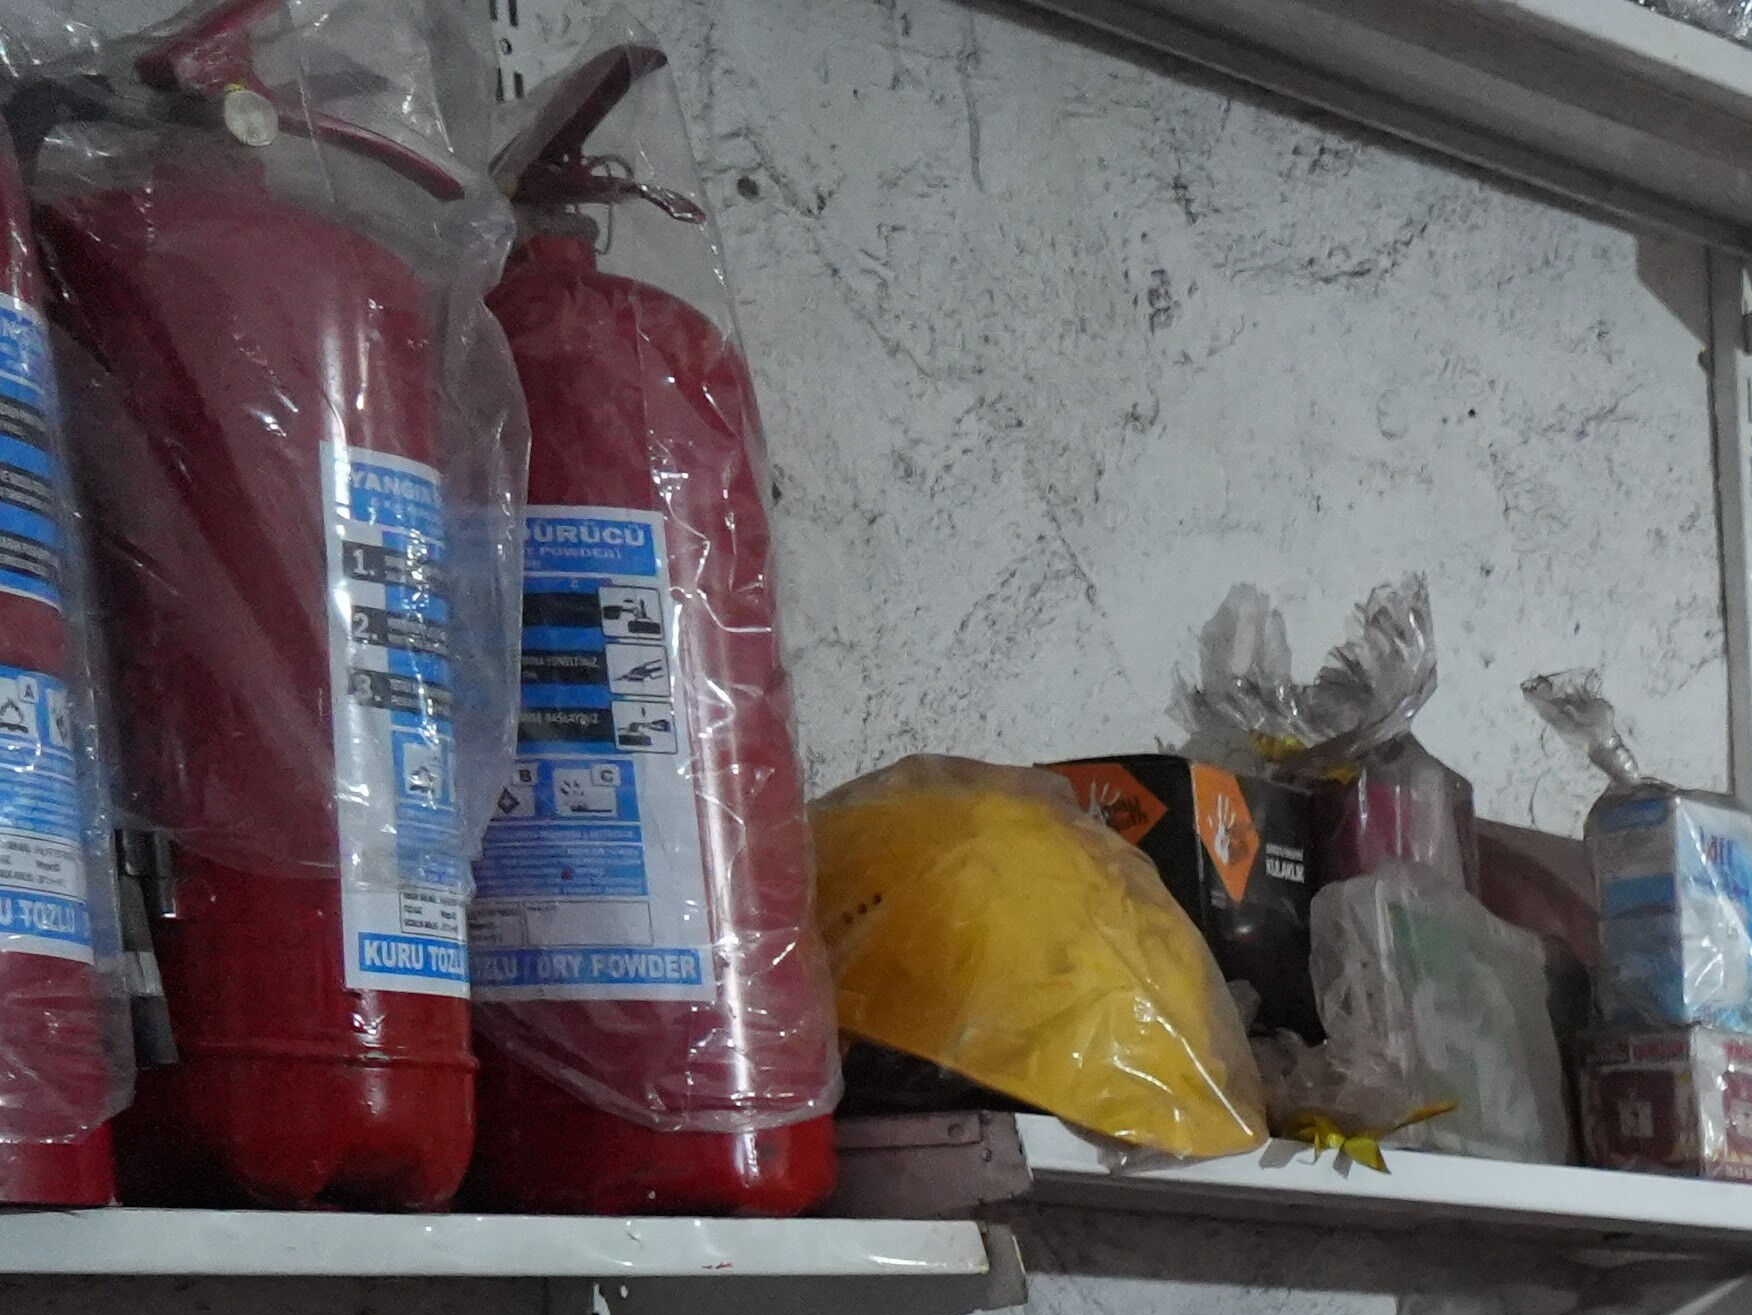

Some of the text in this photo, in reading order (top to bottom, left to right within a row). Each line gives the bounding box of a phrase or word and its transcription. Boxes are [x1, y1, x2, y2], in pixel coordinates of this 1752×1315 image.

[352, 549, 375, 576] 1.
[353, 613, 378, 640] 2.
[364, 939, 424, 968] KURU
[592, 955, 696, 979] POWDER
